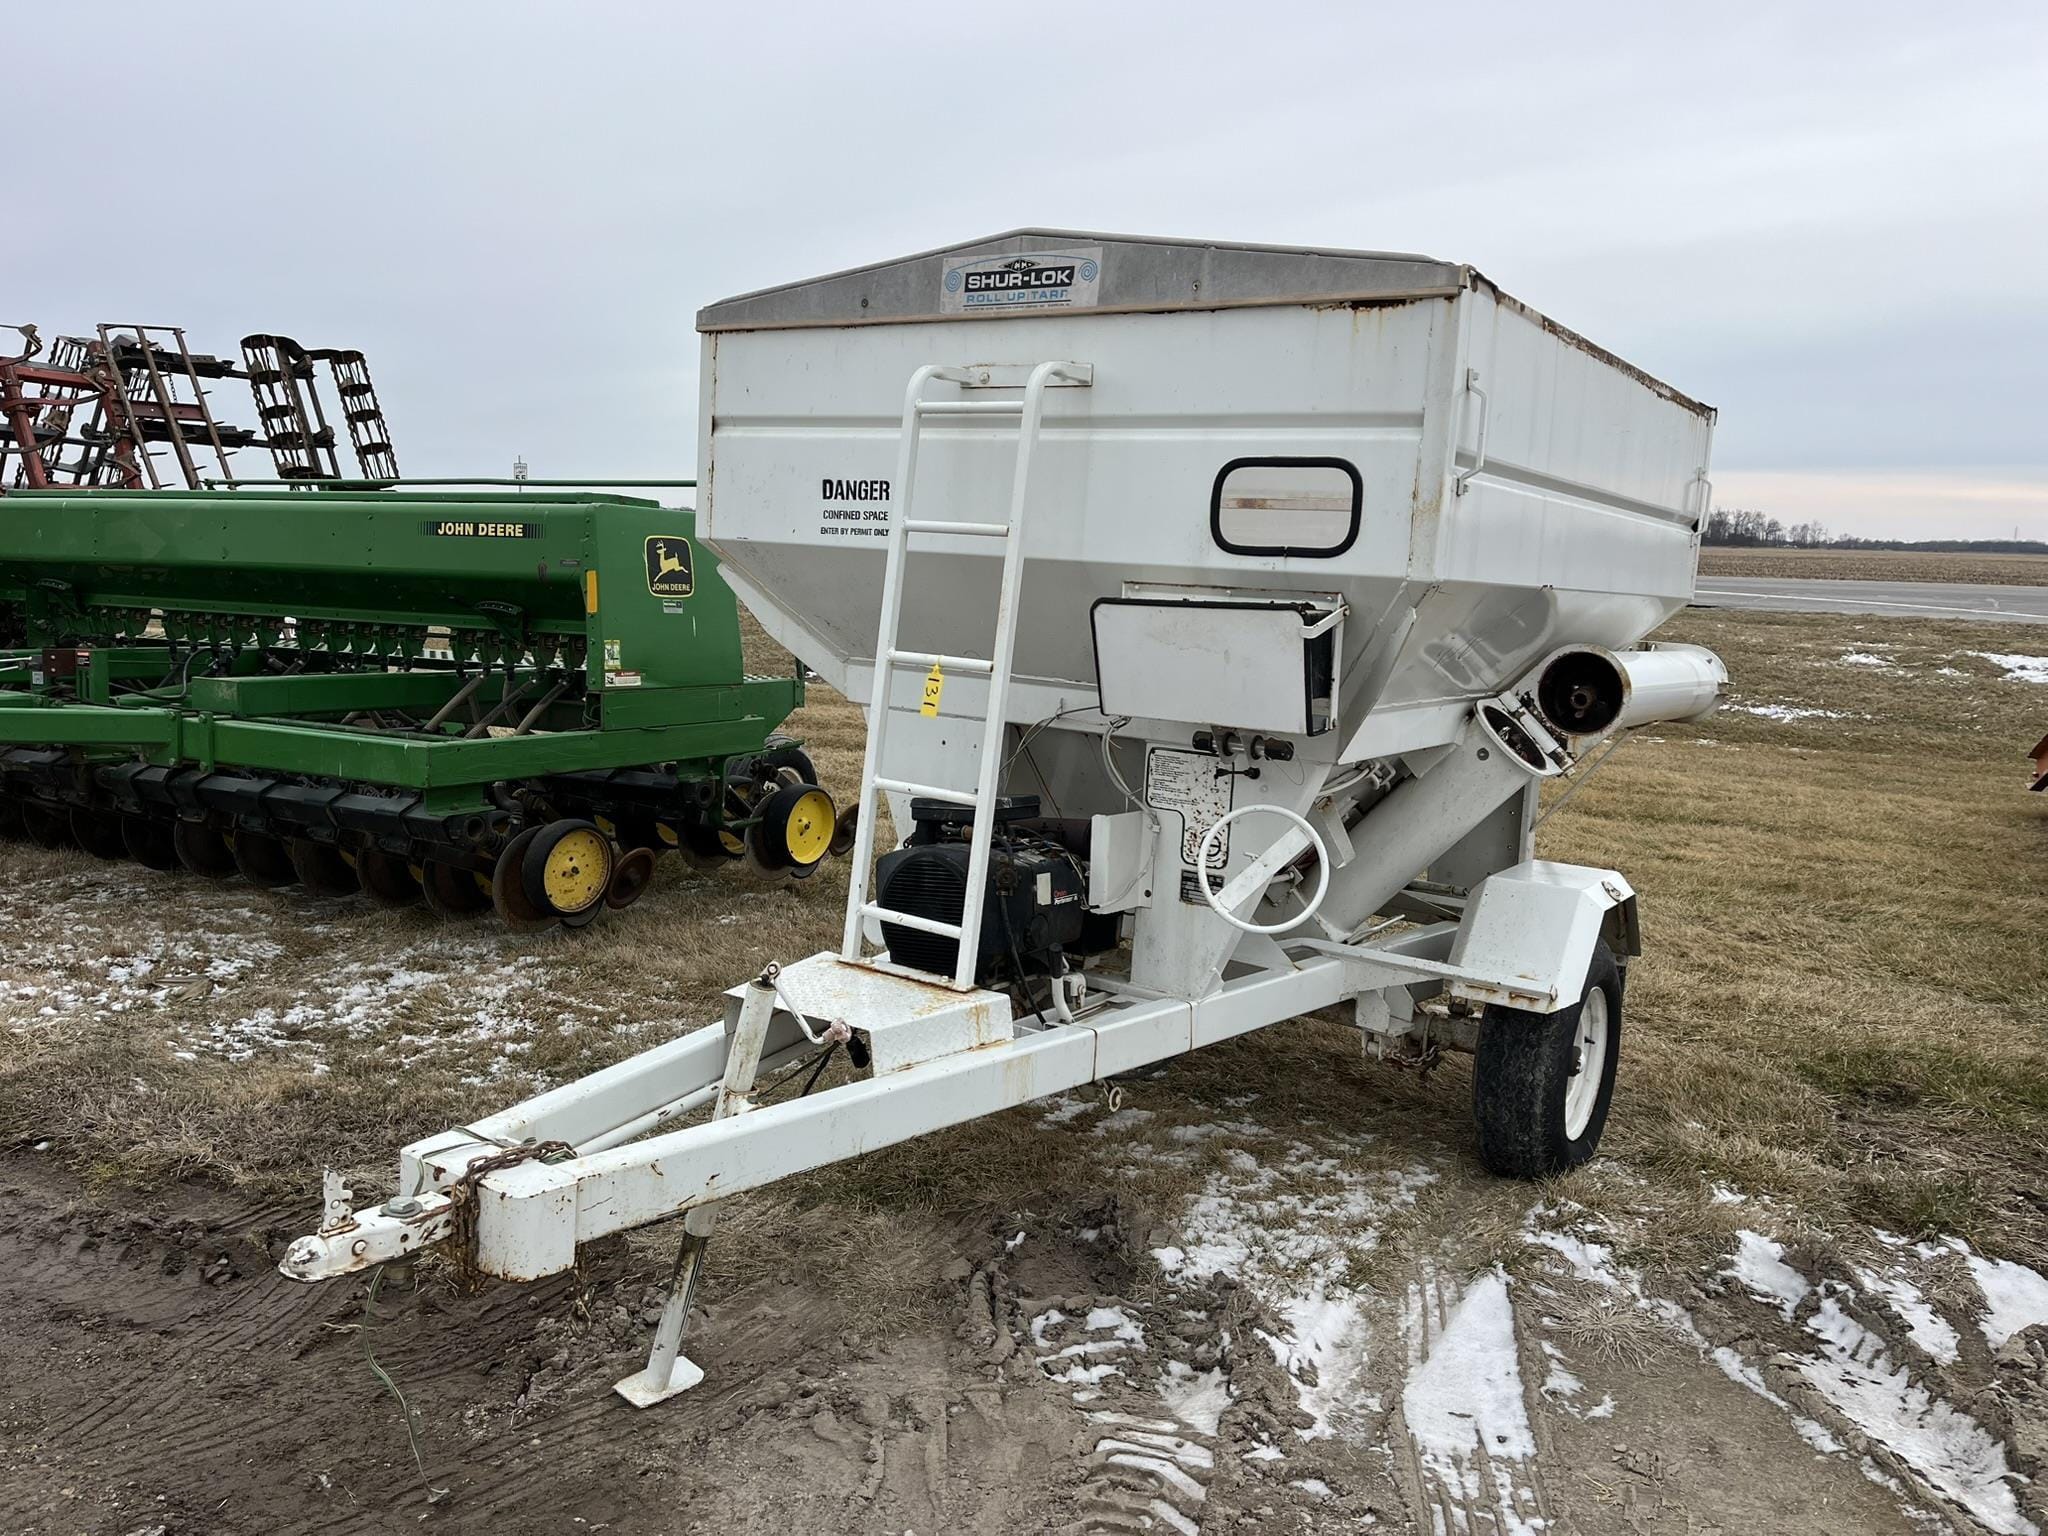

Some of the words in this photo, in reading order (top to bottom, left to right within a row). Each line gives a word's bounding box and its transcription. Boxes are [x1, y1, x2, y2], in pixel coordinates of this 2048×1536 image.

[967, 270, 1072, 289] SHUR-LOK
[966, 293, 1001, 304] ROLL
[1007, 291, 1026, 302] UP
[822, 479, 890, 501] DANGER
[823, 509, 861, 520] CONFINED
[863, 510, 889, 521] SPACE
[437, 522, 474, 536] JOHN
[478, 523, 524, 537] DEERE
[820, 526, 839, 535] ENTER
[840, 527, 849, 535] BY
[850, 528, 872, 536] PERMIT
[873, 528, 889, 537] ONLY
[652, 583, 670, 591] JOHN
[670, 584, 691, 592] DEERE
[923, 678, 940, 707] 131
